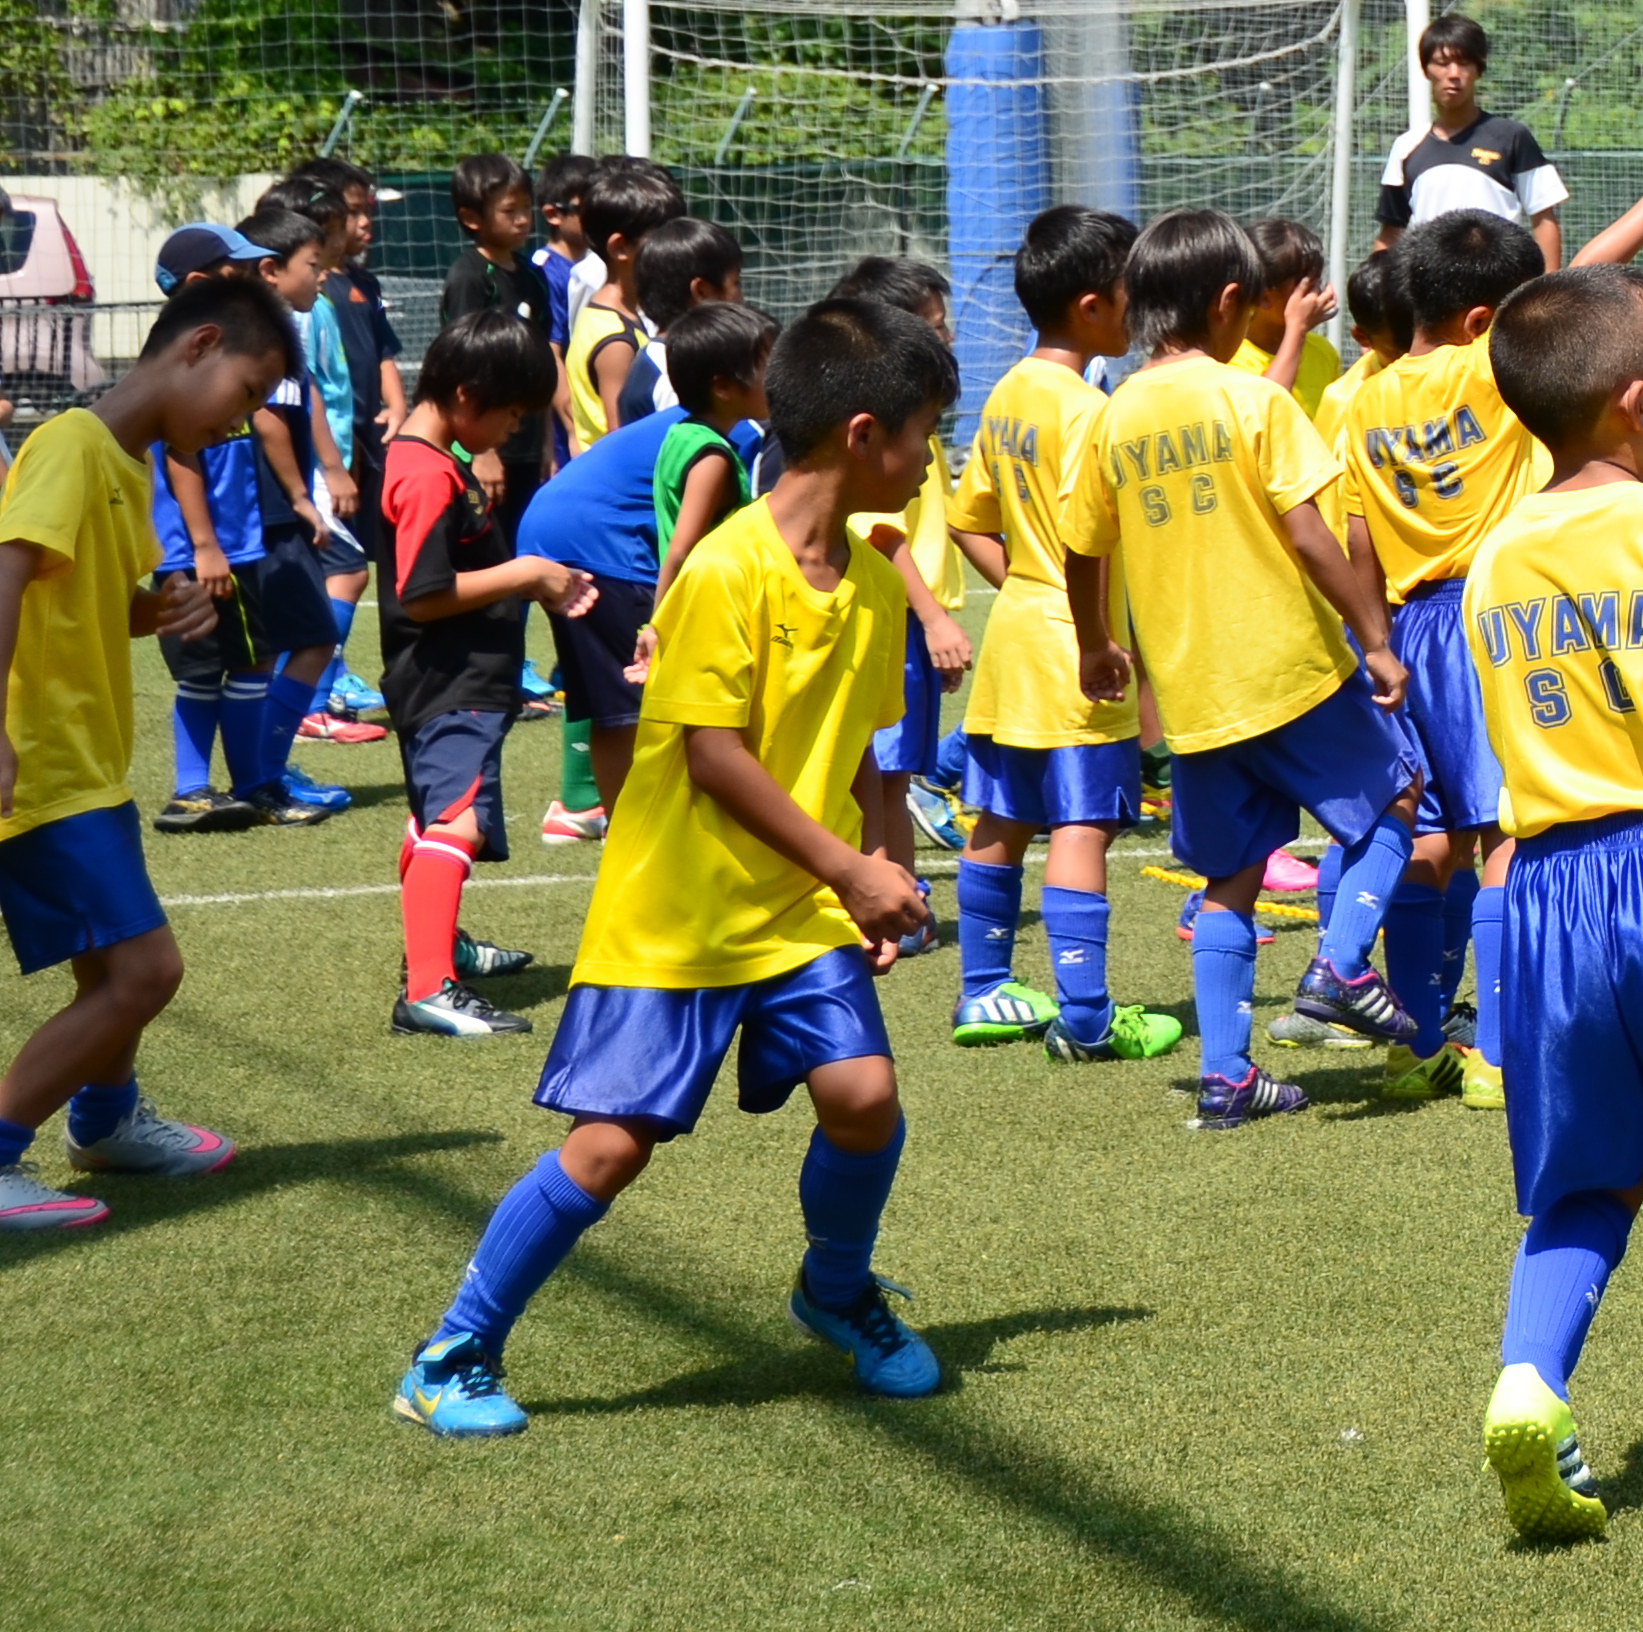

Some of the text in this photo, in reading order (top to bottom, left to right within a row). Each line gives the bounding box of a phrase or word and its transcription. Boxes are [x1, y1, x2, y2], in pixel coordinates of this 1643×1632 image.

[1138, 472, 1217, 528] S C
[1524, 667, 1572, 729] S
